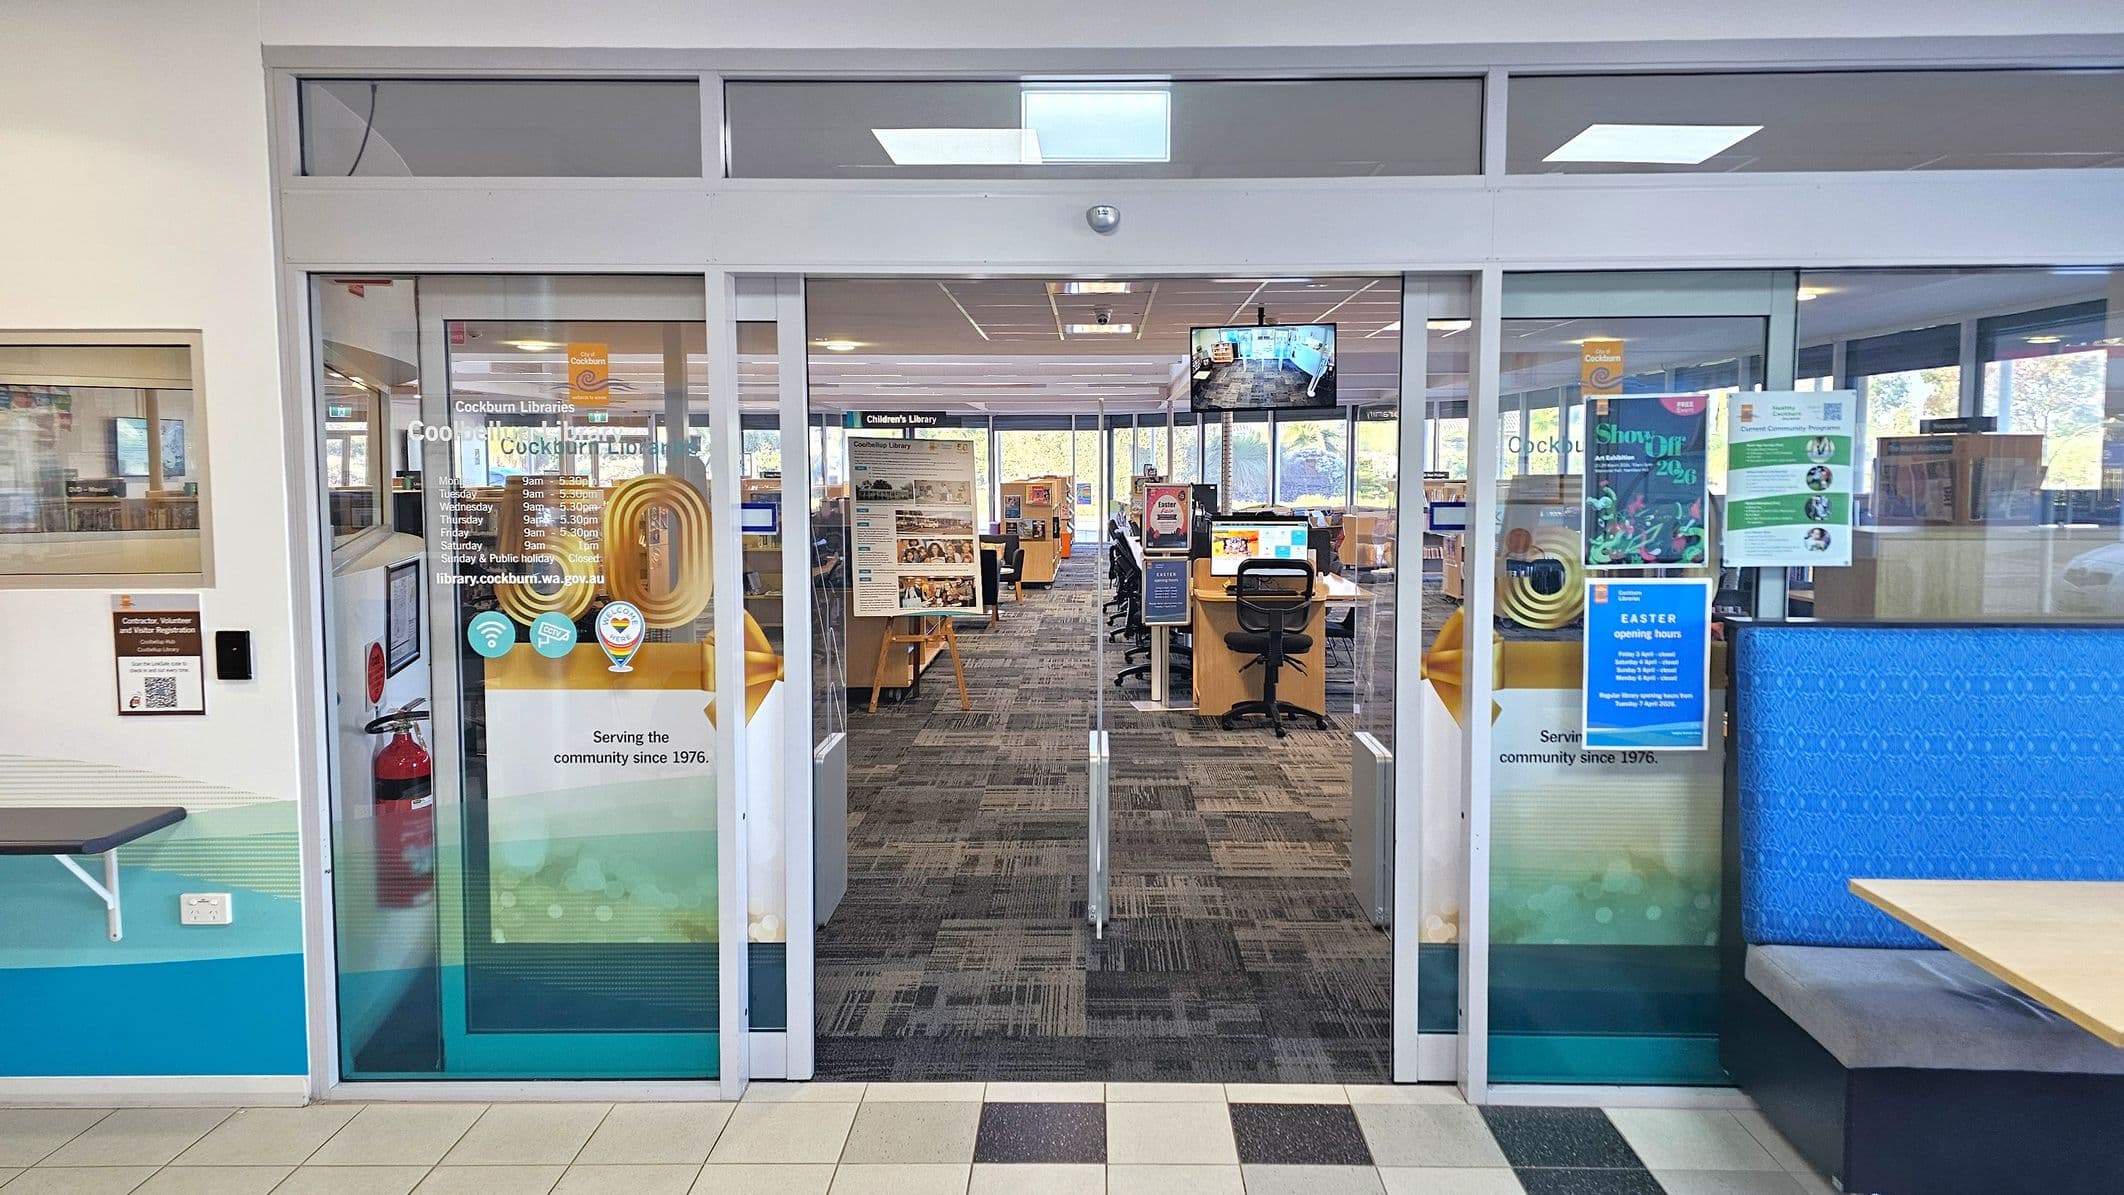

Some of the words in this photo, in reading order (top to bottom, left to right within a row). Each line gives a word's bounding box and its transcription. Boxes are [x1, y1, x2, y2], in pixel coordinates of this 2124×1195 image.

[455, 400, 515, 413] Cockburn
[520, 400, 575, 413] Libraries
[866, 415, 906, 423] Children's
[909, 414, 937, 424] Library
[1594, 423, 1652, 444] Show
[501, 436, 598, 455] Cockburn
[608, 436, 699, 456] Librar
[1508, 436, 1584, 454] Cockbu
[1645, 435, 1687, 458] Off
[522, 477, 543, 485] 9am
[440, 490, 477, 500] Tuesday
[522, 490, 544, 498] 9am
[559, 490, 598, 500] 5.30pm
[440, 503, 493, 513] Wednesday
[523, 503, 544, 512] 9am
[560, 503, 598, 513] 5.30pm
[440, 516, 483, 526] Thursday
[523, 516, 545, 525] 9am
[560, 516, 598, 526] 5.30pm
[440, 528, 470, 539] Friday
[524, 529, 545, 537] 9am
[560, 528, 599, 539] 5.30pm
[440, 541, 483, 552] Saturday
[524, 542, 546, 550] 9am
[579, 542, 599, 552] 1pm
[441, 554, 476, 564] Sunday
[479, 554, 486, 562] &
[489, 554, 519, 562] Public
[521, 554, 555, 564] holiday
[568, 554, 599, 562] Closed
[436, 573, 604, 586] library.cockburn.wa.gov.au
[602, 606, 639, 626] WELCOME
[1621, 614, 1677, 623] EASTER
[542, 626, 562, 637] CCTV
[1614, 629, 1652, 640] opening
[1655, 629, 1682, 638] hours
[593, 730, 644, 746] Serving
[648, 731, 669, 743] the
[1540, 730, 1582, 743] Servin
[554, 751, 629, 766] community
[633, 751, 668, 763] since
[672, 751, 709, 763] 1976.
[1500, 751, 1576, 766] community
[1580, 751, 1615, 763] since
[1621, 751, 1658, 764] 1976.
